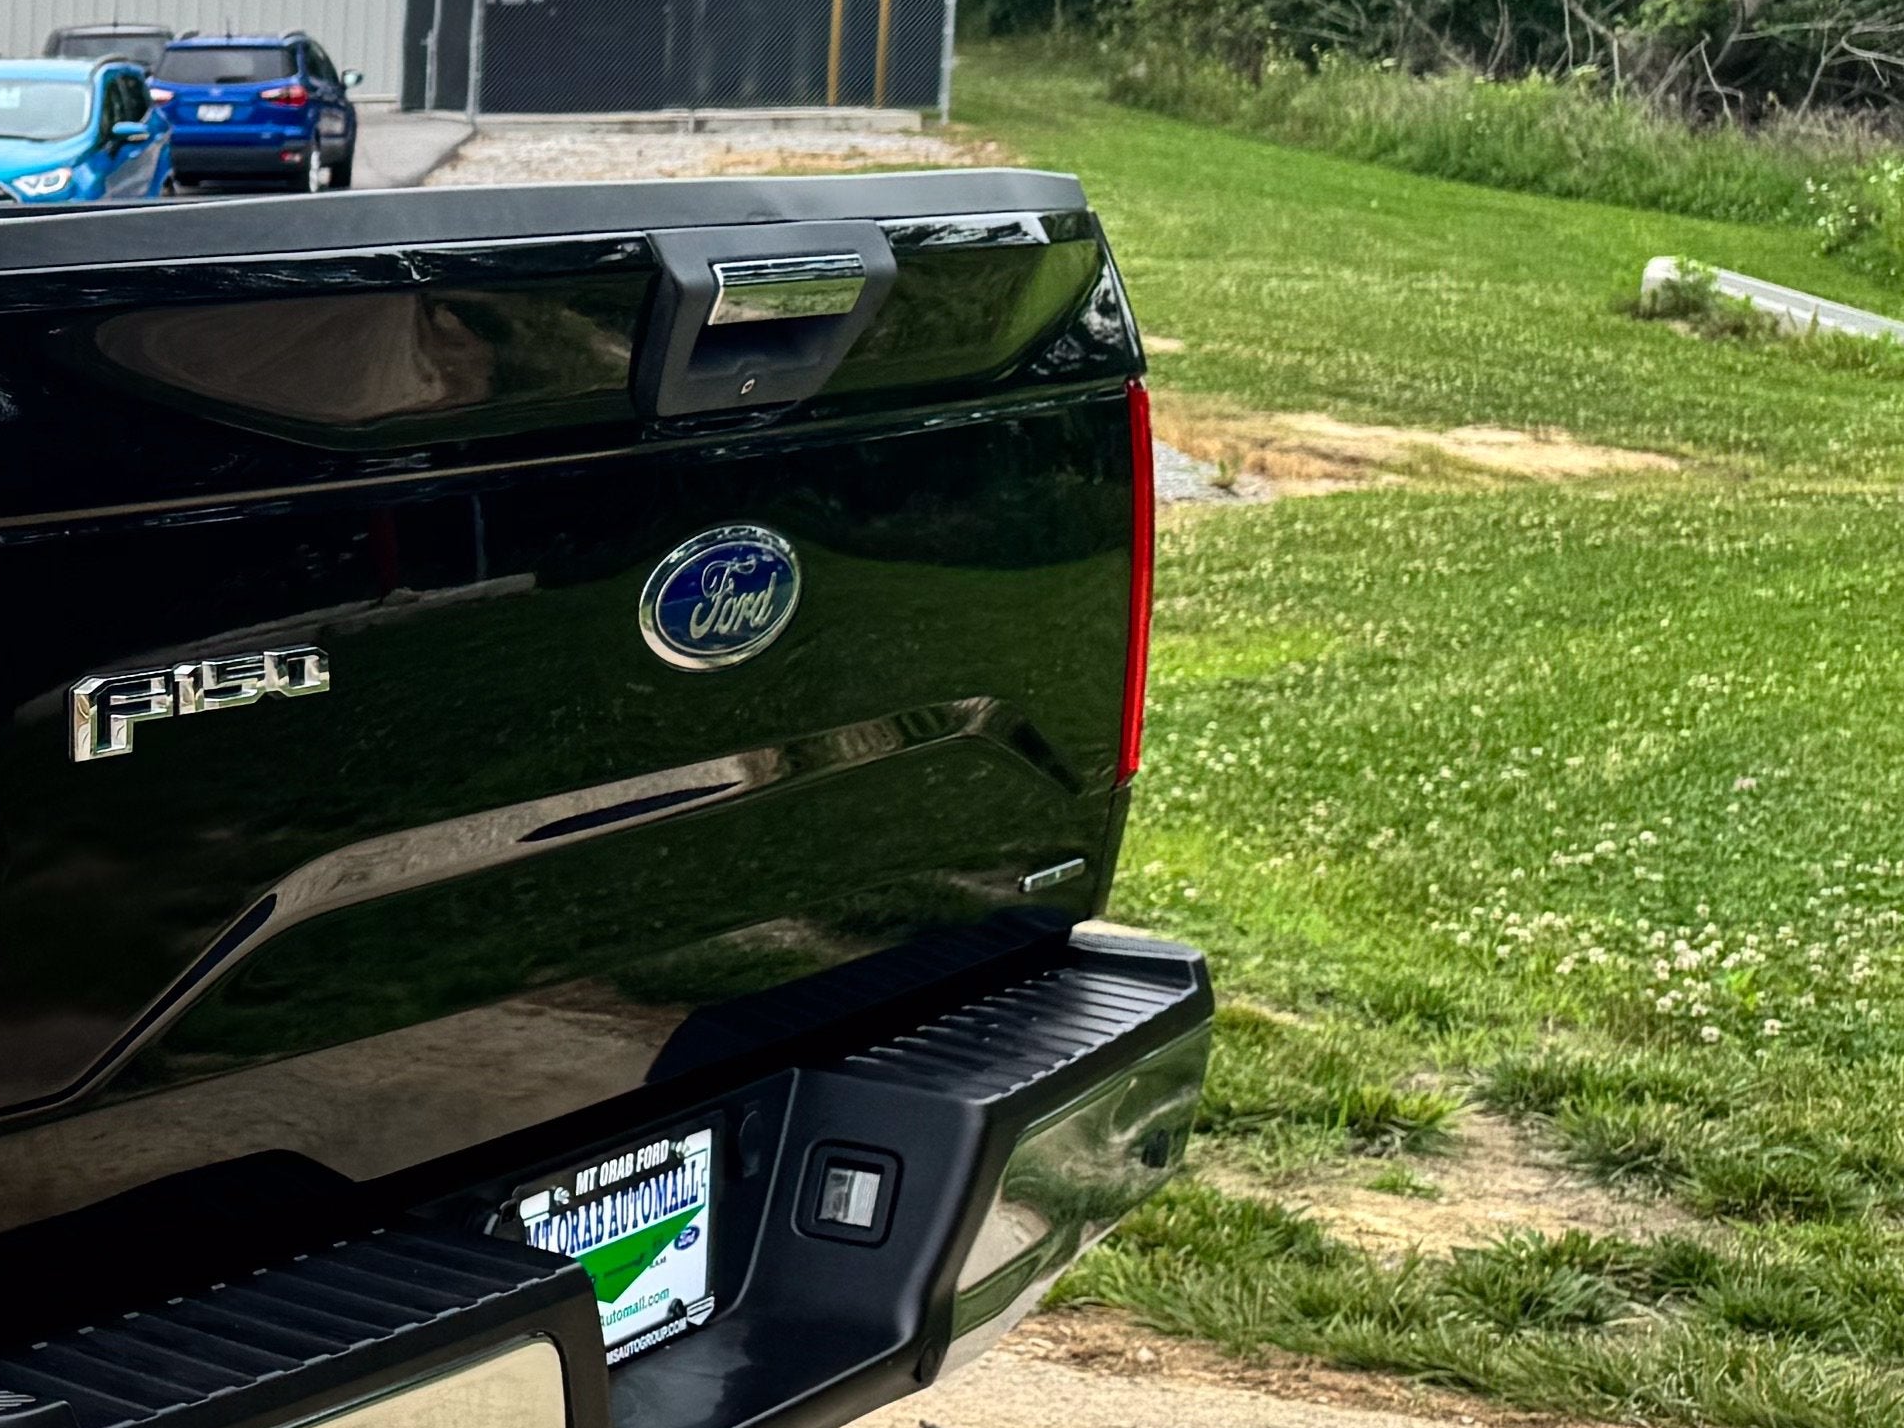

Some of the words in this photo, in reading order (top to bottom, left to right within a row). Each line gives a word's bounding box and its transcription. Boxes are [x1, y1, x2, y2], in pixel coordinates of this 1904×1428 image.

[687, 556, 779, 641] Ford
[556, 1206, 606, 1256] ORAB
[608, 1156, 699, 1239] AUTOMALL
[575, 1166, 598, 1196] MT
[599, 1152, 634, 1187] ORAB
[636, 1139, 670, 1173] FORD
